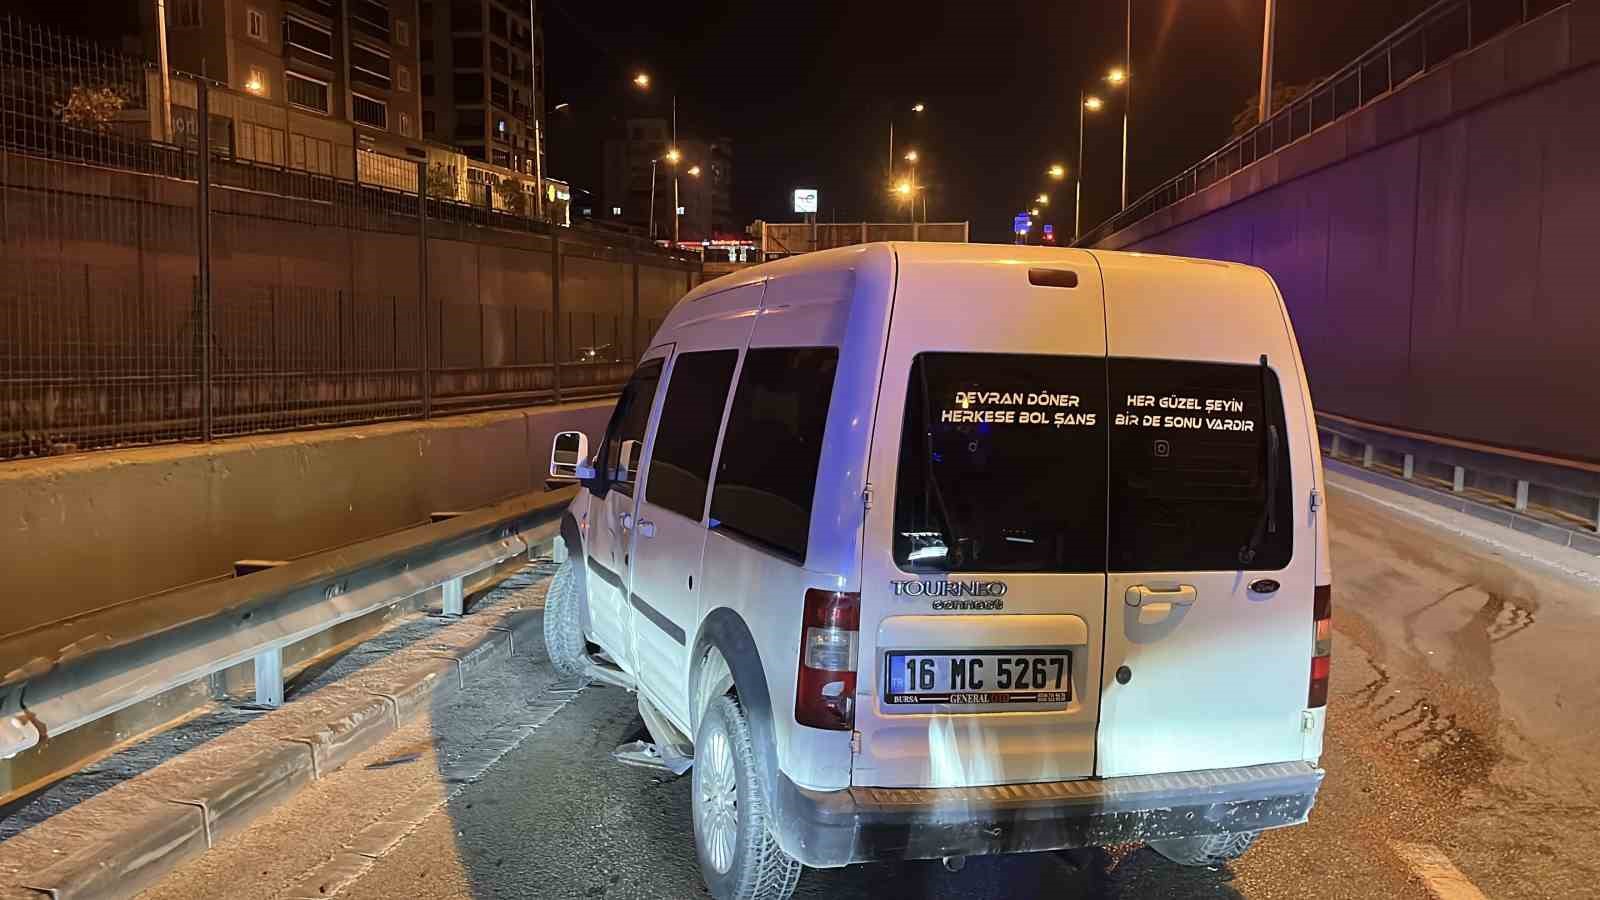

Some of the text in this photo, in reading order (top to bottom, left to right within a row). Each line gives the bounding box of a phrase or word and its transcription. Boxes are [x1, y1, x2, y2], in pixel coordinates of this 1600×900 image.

[955, 390, 1080, 407] DEVRAN DÖNER
[1127, 393, 1244, 413] HER GÜZEL ŞEYİN
[941, 410, 1097, 428] HERKESE BOL ŞANS
[1114, 411, 1255, 432] BİR DE SONU VARDIR
[890, 580, 1008, 596] TOURNEO
[906, 657, 1064, 690] 16 MC 5267
[894, 695, 918, 703] BURSA
[950, 694, 990, 704] GENERAL
